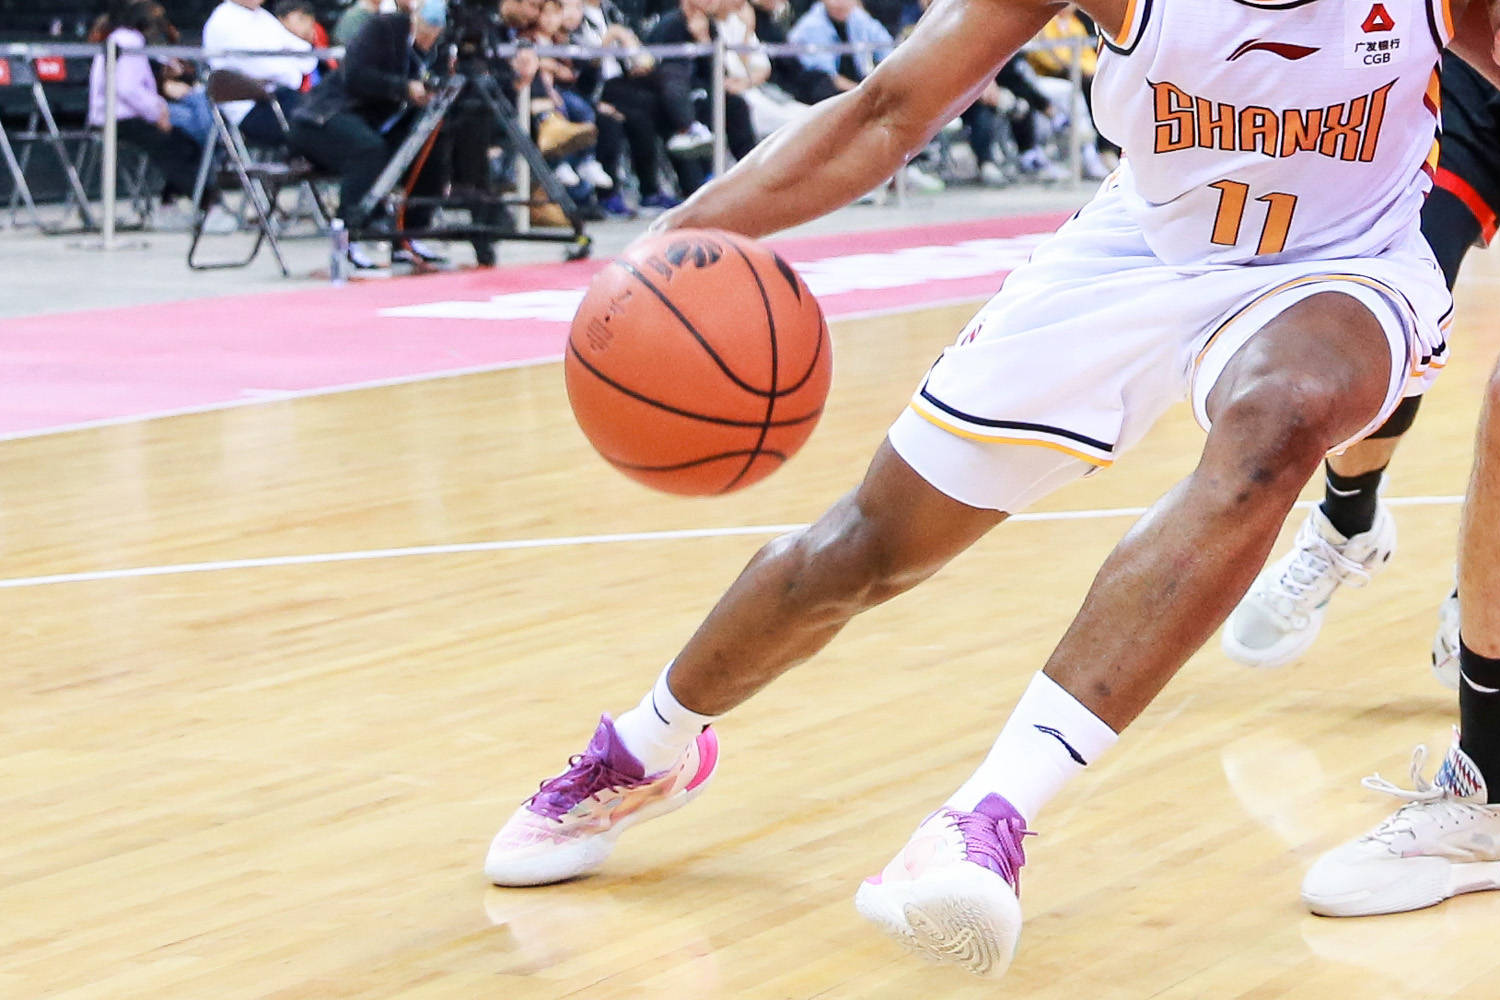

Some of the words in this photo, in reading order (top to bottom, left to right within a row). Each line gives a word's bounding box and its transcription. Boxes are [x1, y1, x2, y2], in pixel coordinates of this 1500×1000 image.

[1354, 38, 1400, 53] 广发银行
[1363, 52, 1391, 66] CGB
[1145, 76, 1401, 163] SHANXI
[1207, 179, 1298, 256] 11
